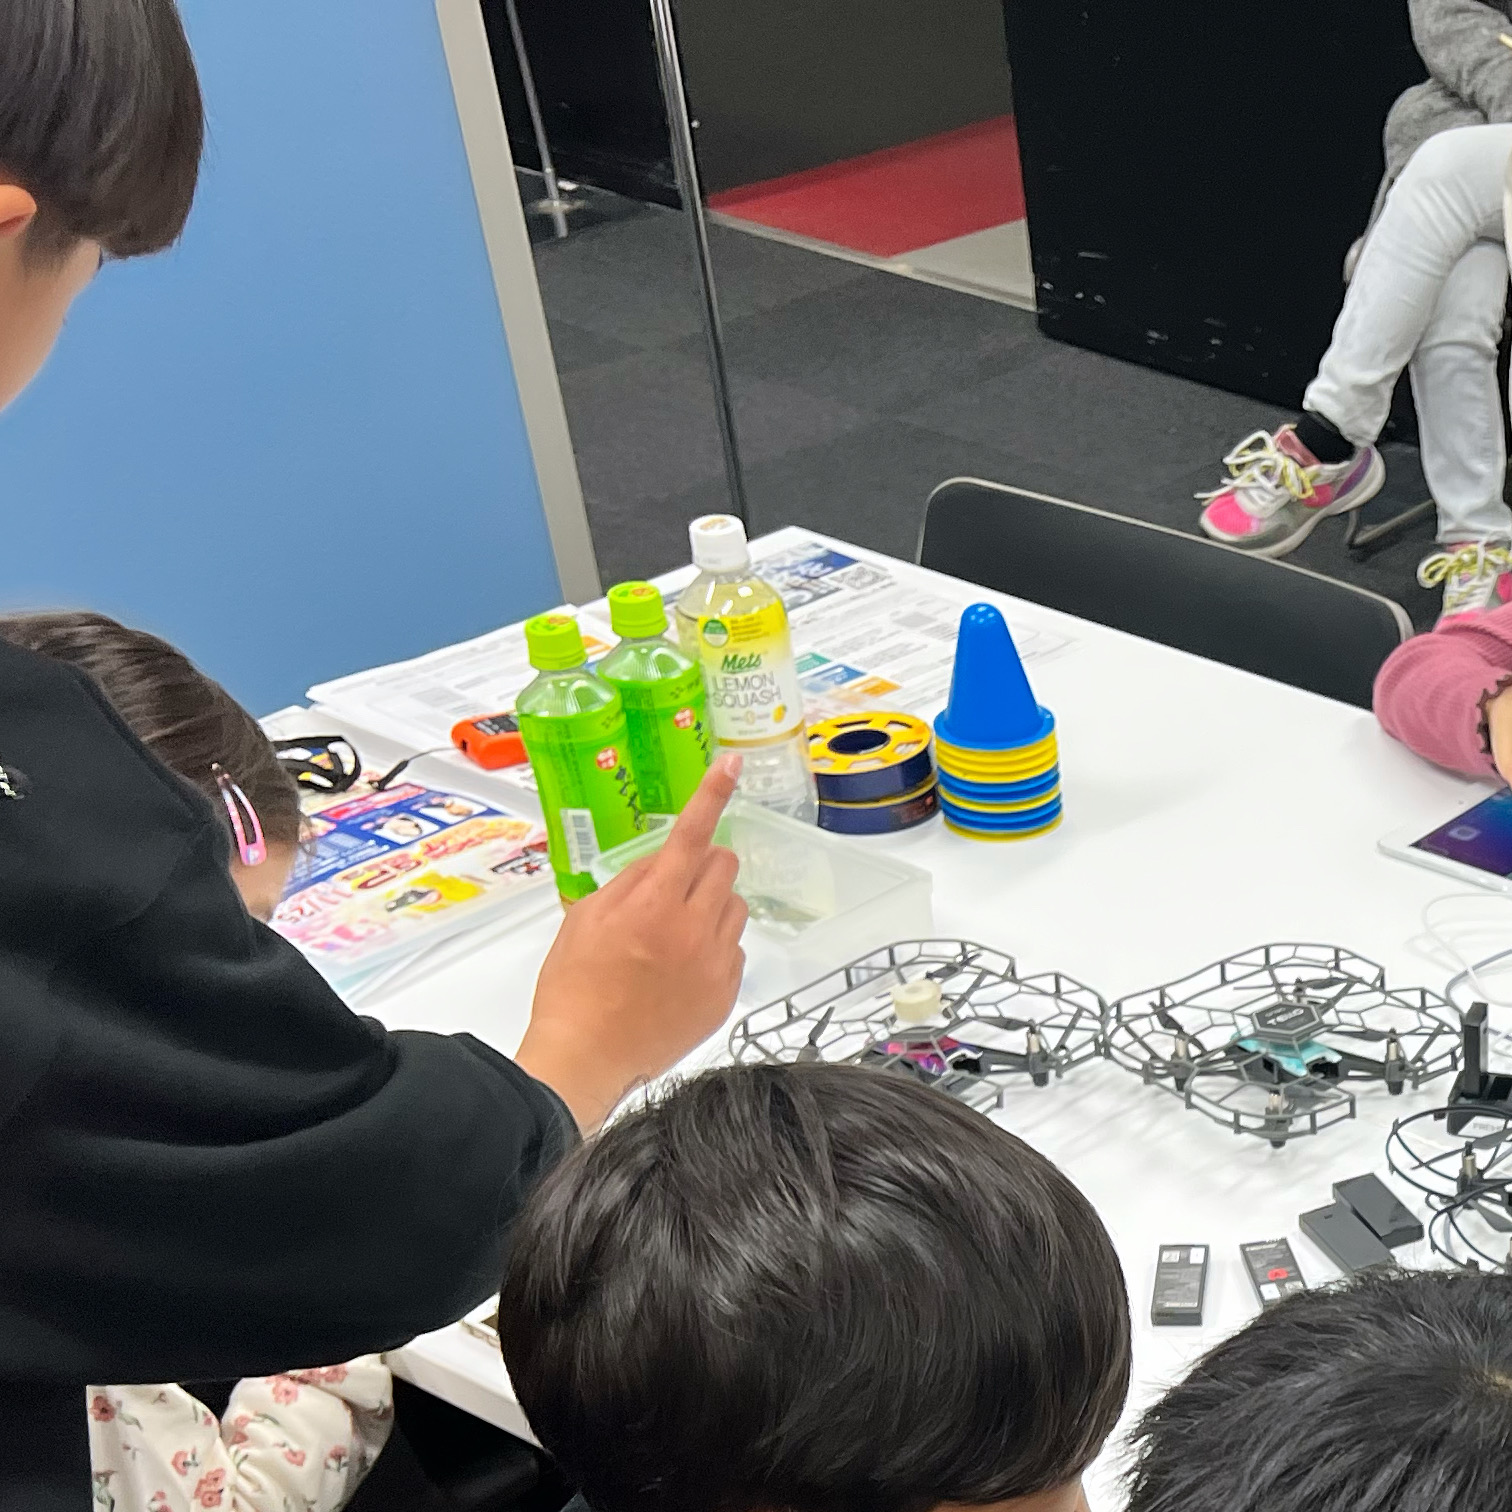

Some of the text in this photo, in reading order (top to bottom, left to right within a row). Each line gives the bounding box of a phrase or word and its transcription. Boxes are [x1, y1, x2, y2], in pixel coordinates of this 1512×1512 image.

[721, 652, 762, 674] Mets
[711, 671, 775, 693] LEMON
[712, 686, 782, 709] SQUASH
